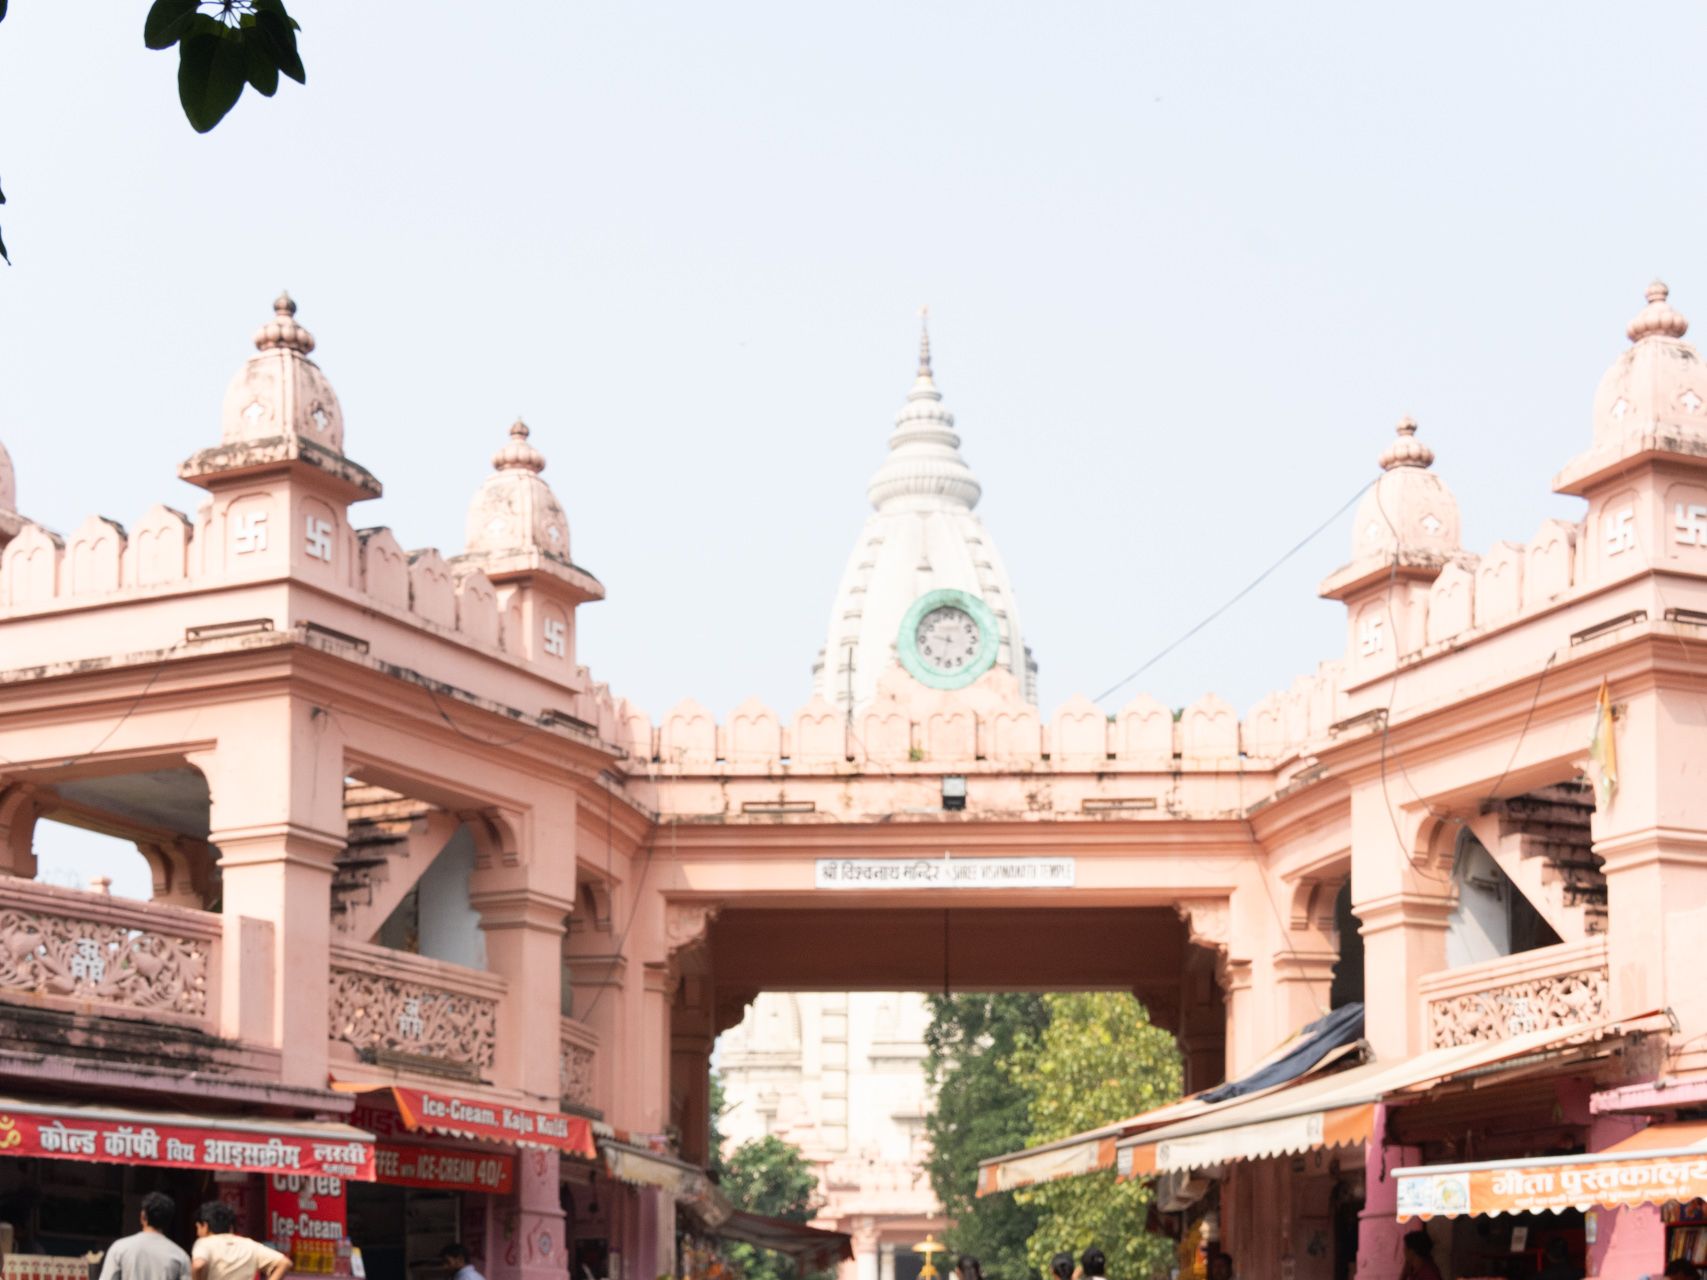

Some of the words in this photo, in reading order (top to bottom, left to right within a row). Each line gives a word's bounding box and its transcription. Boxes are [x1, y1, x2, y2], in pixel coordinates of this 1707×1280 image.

[422, 1094, 499, 1127] Ice-Cream,
[503, 1108, 533, 1135] Kaju
[537, 1114, 569, 1138] Kulfi
[38, 1119, 97, 1155] कोल्ड
[103, 1126, 160, 1160] कॉफी
[203, 1137, 301, 1169] आइसक्रीम
[417, 1154, 475, 1184] ICE-CREAM
[1492, 1168, 1554, 1196] गीता
[271, 1211, 343, 1239] Ice-Cream
